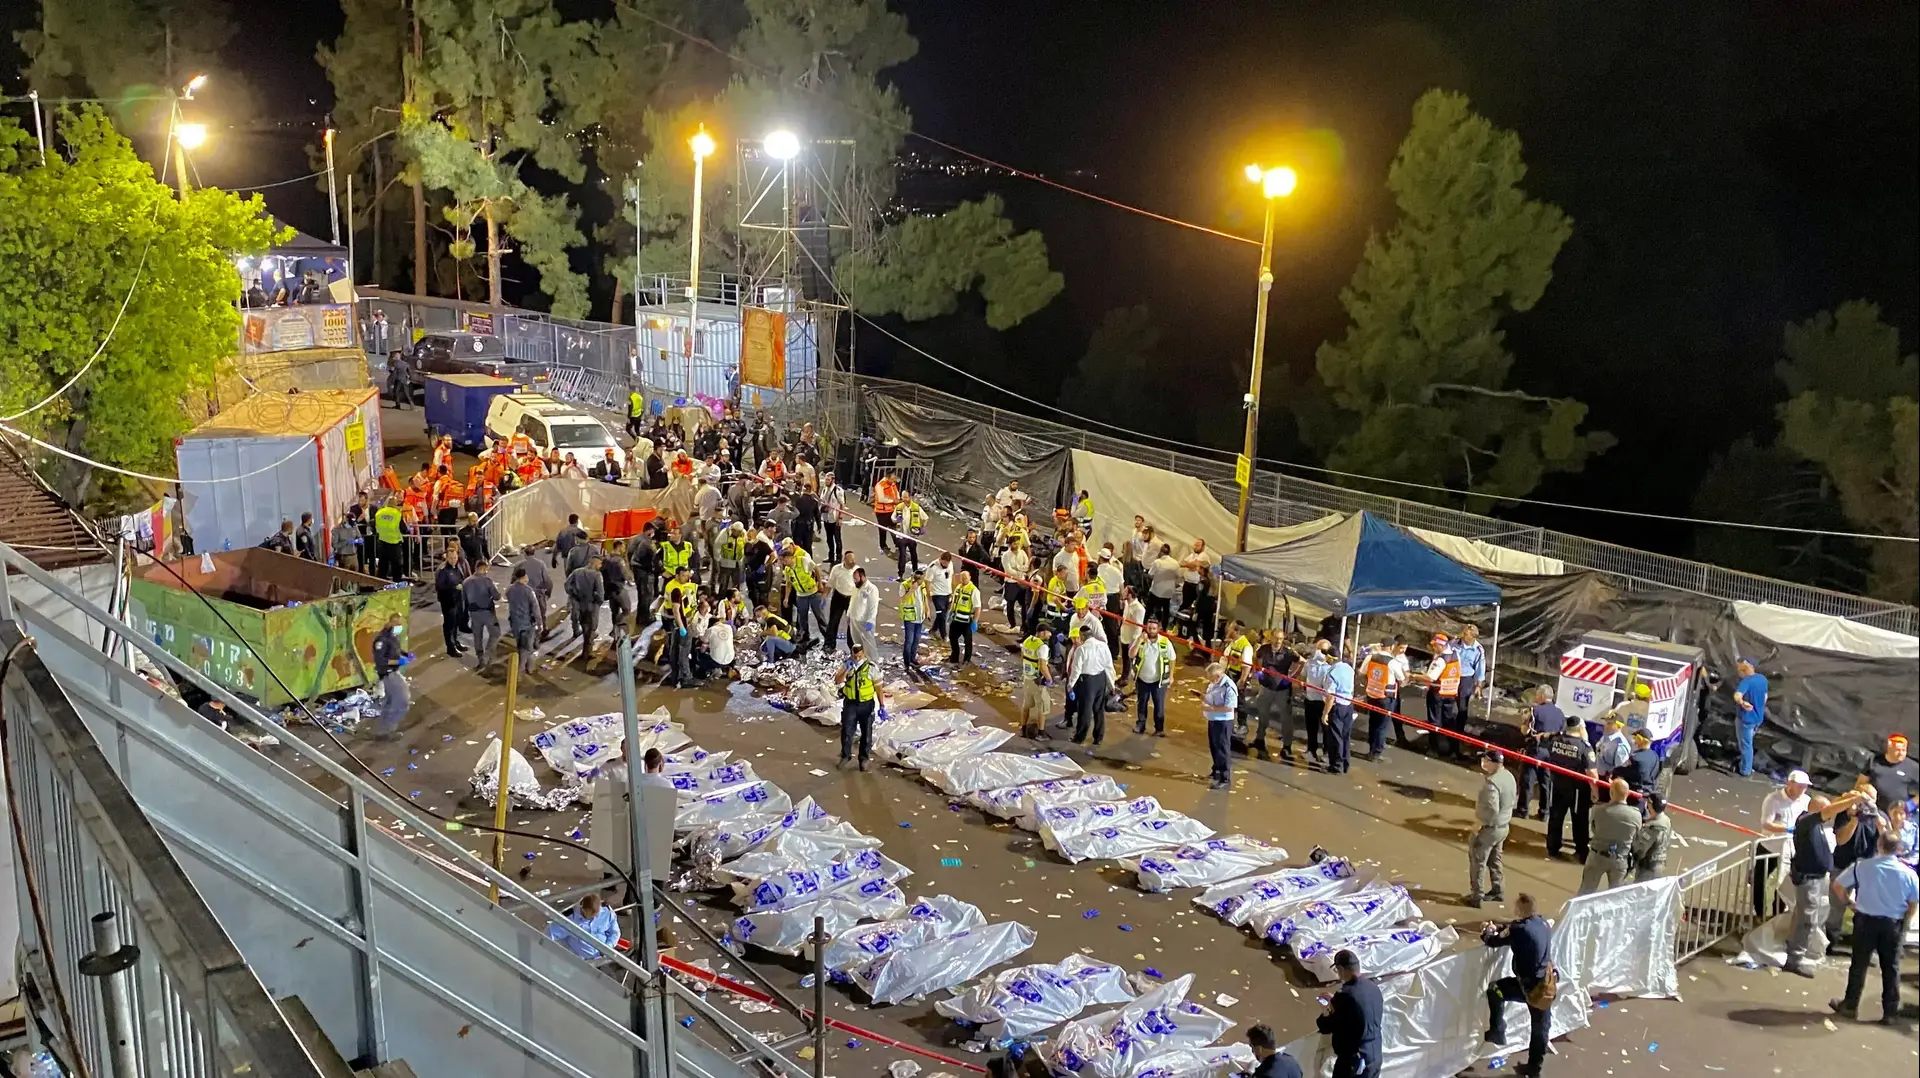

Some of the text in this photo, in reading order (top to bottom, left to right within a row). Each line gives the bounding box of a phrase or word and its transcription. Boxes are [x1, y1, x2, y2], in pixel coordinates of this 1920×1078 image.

[324, 318, 347, 327] 1000
[323, 328, 347, 336] סיומי
[1551, 746, 1578, 758] POLICE
